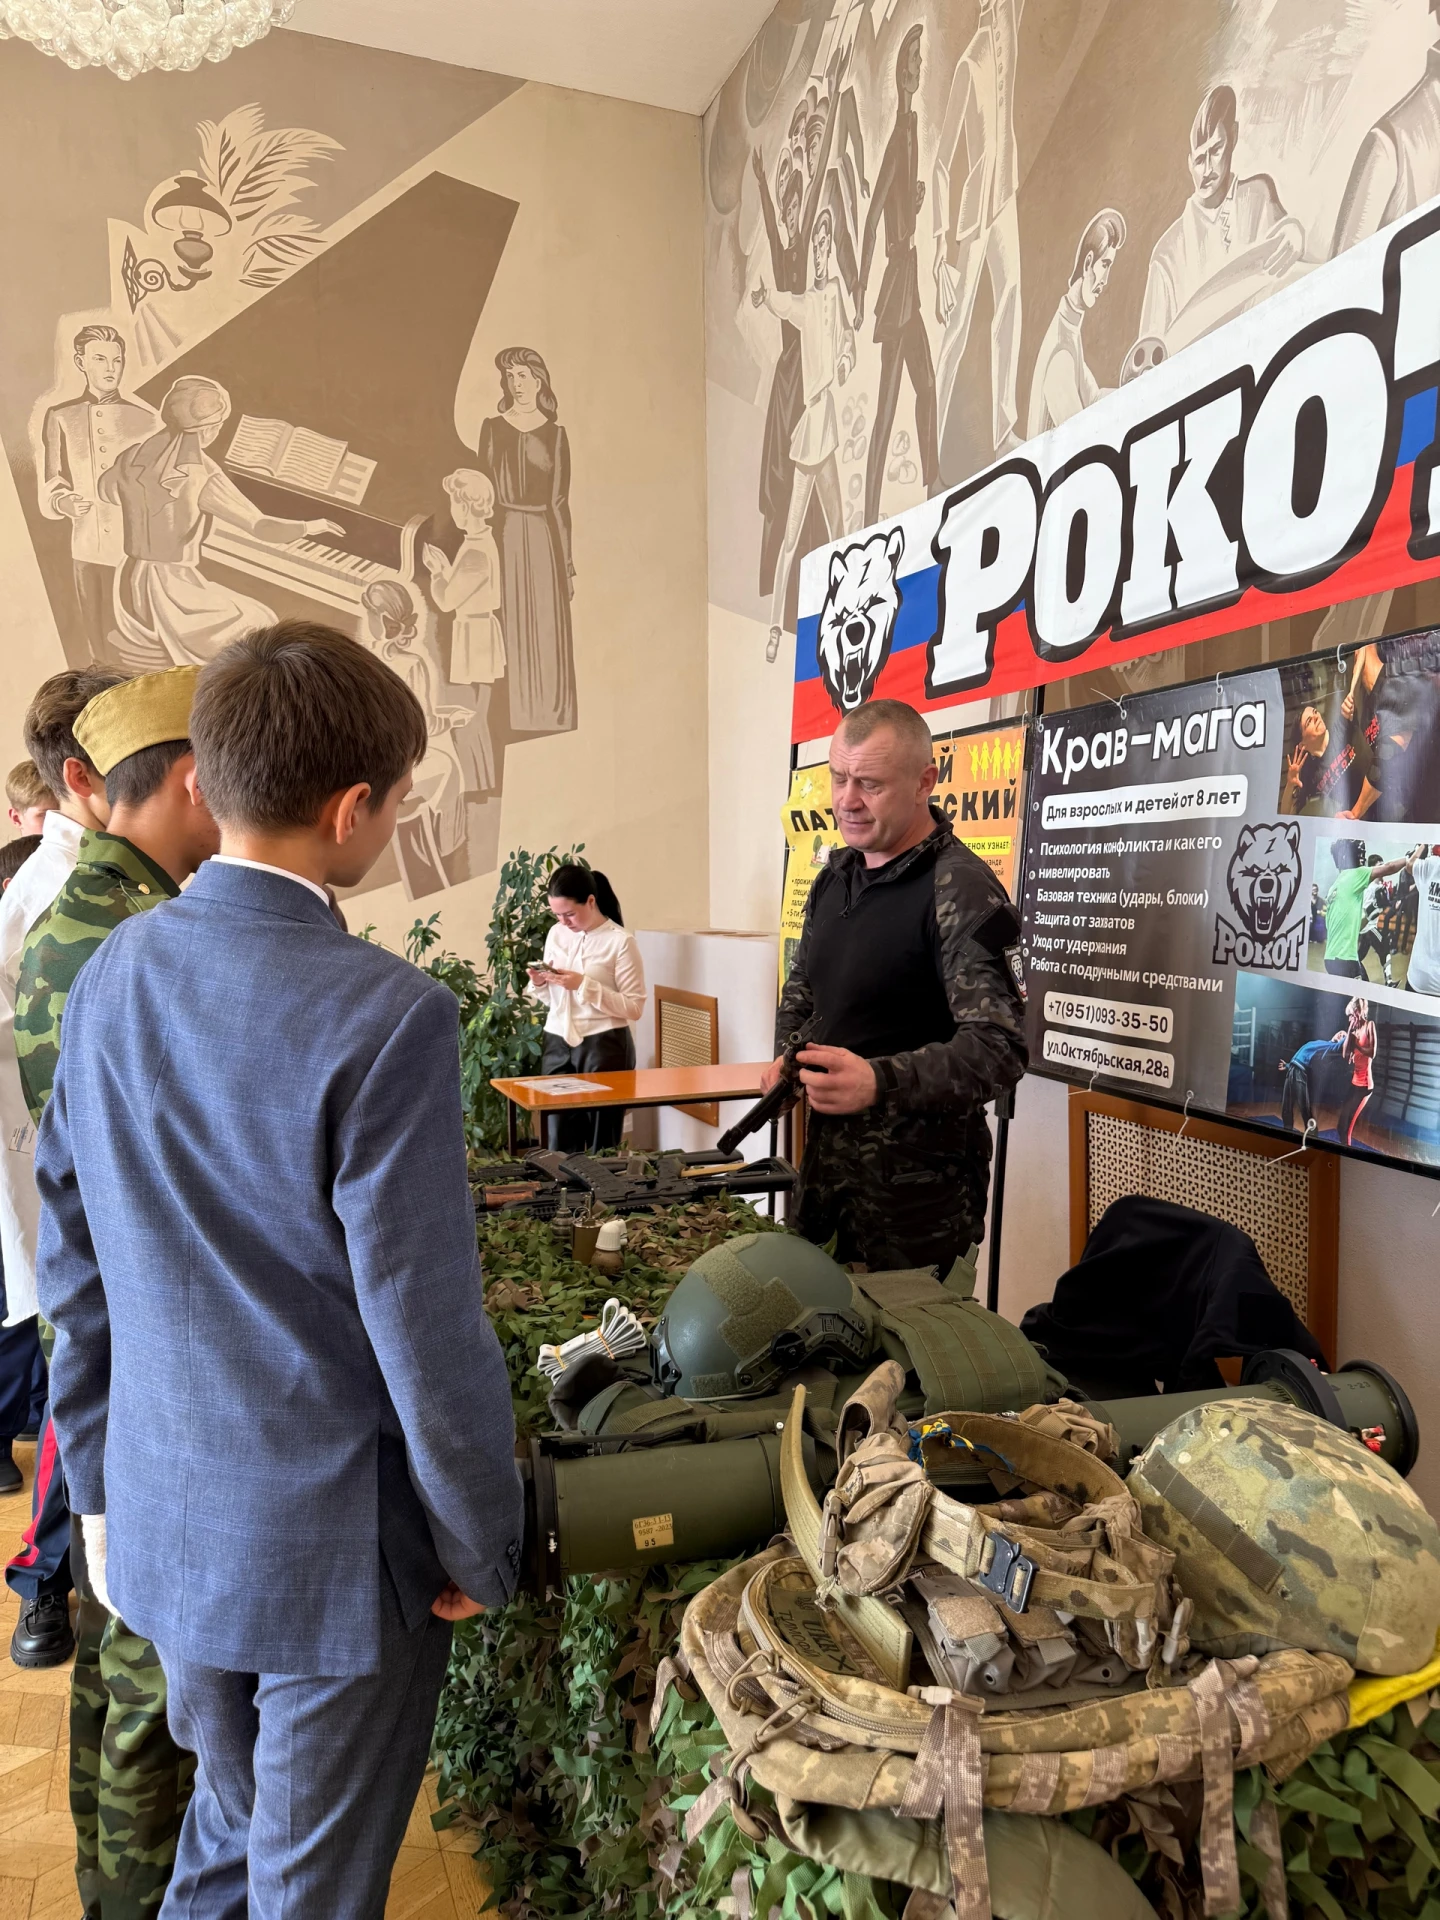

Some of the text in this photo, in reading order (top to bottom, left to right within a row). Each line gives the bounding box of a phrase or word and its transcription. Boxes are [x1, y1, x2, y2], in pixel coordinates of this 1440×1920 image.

[1041, 701, 1265, 785] Крав-мага
[1046, 790, 1241, 823] Для взрослых и детей от 8 лет
[964, 842, 985, 850] ЕНОК
[1040, 836, 1222, 857] Психология конфликта и как его
[1038, 866, 1110, 882] нивелировать
[1037, 888, 1209, 908] Базовая техника (удары, блоки)
[1034, 911, 1135, 930] Защита от захватов
[1032, 934, 1053, 951] Уход
[1053, 938, 1065, 950] от
[1066, 939, 1127, 956] удержания
[1212, 912, 1306, 971] РОКОТ
[1030, 957, 1223, 992] Работа с подручными средствами
[1048, 1000, 1168, 1034] +7(951)093-35-50
[1047, 1040, 1169, 1079] ул.Октябрьская,28а
